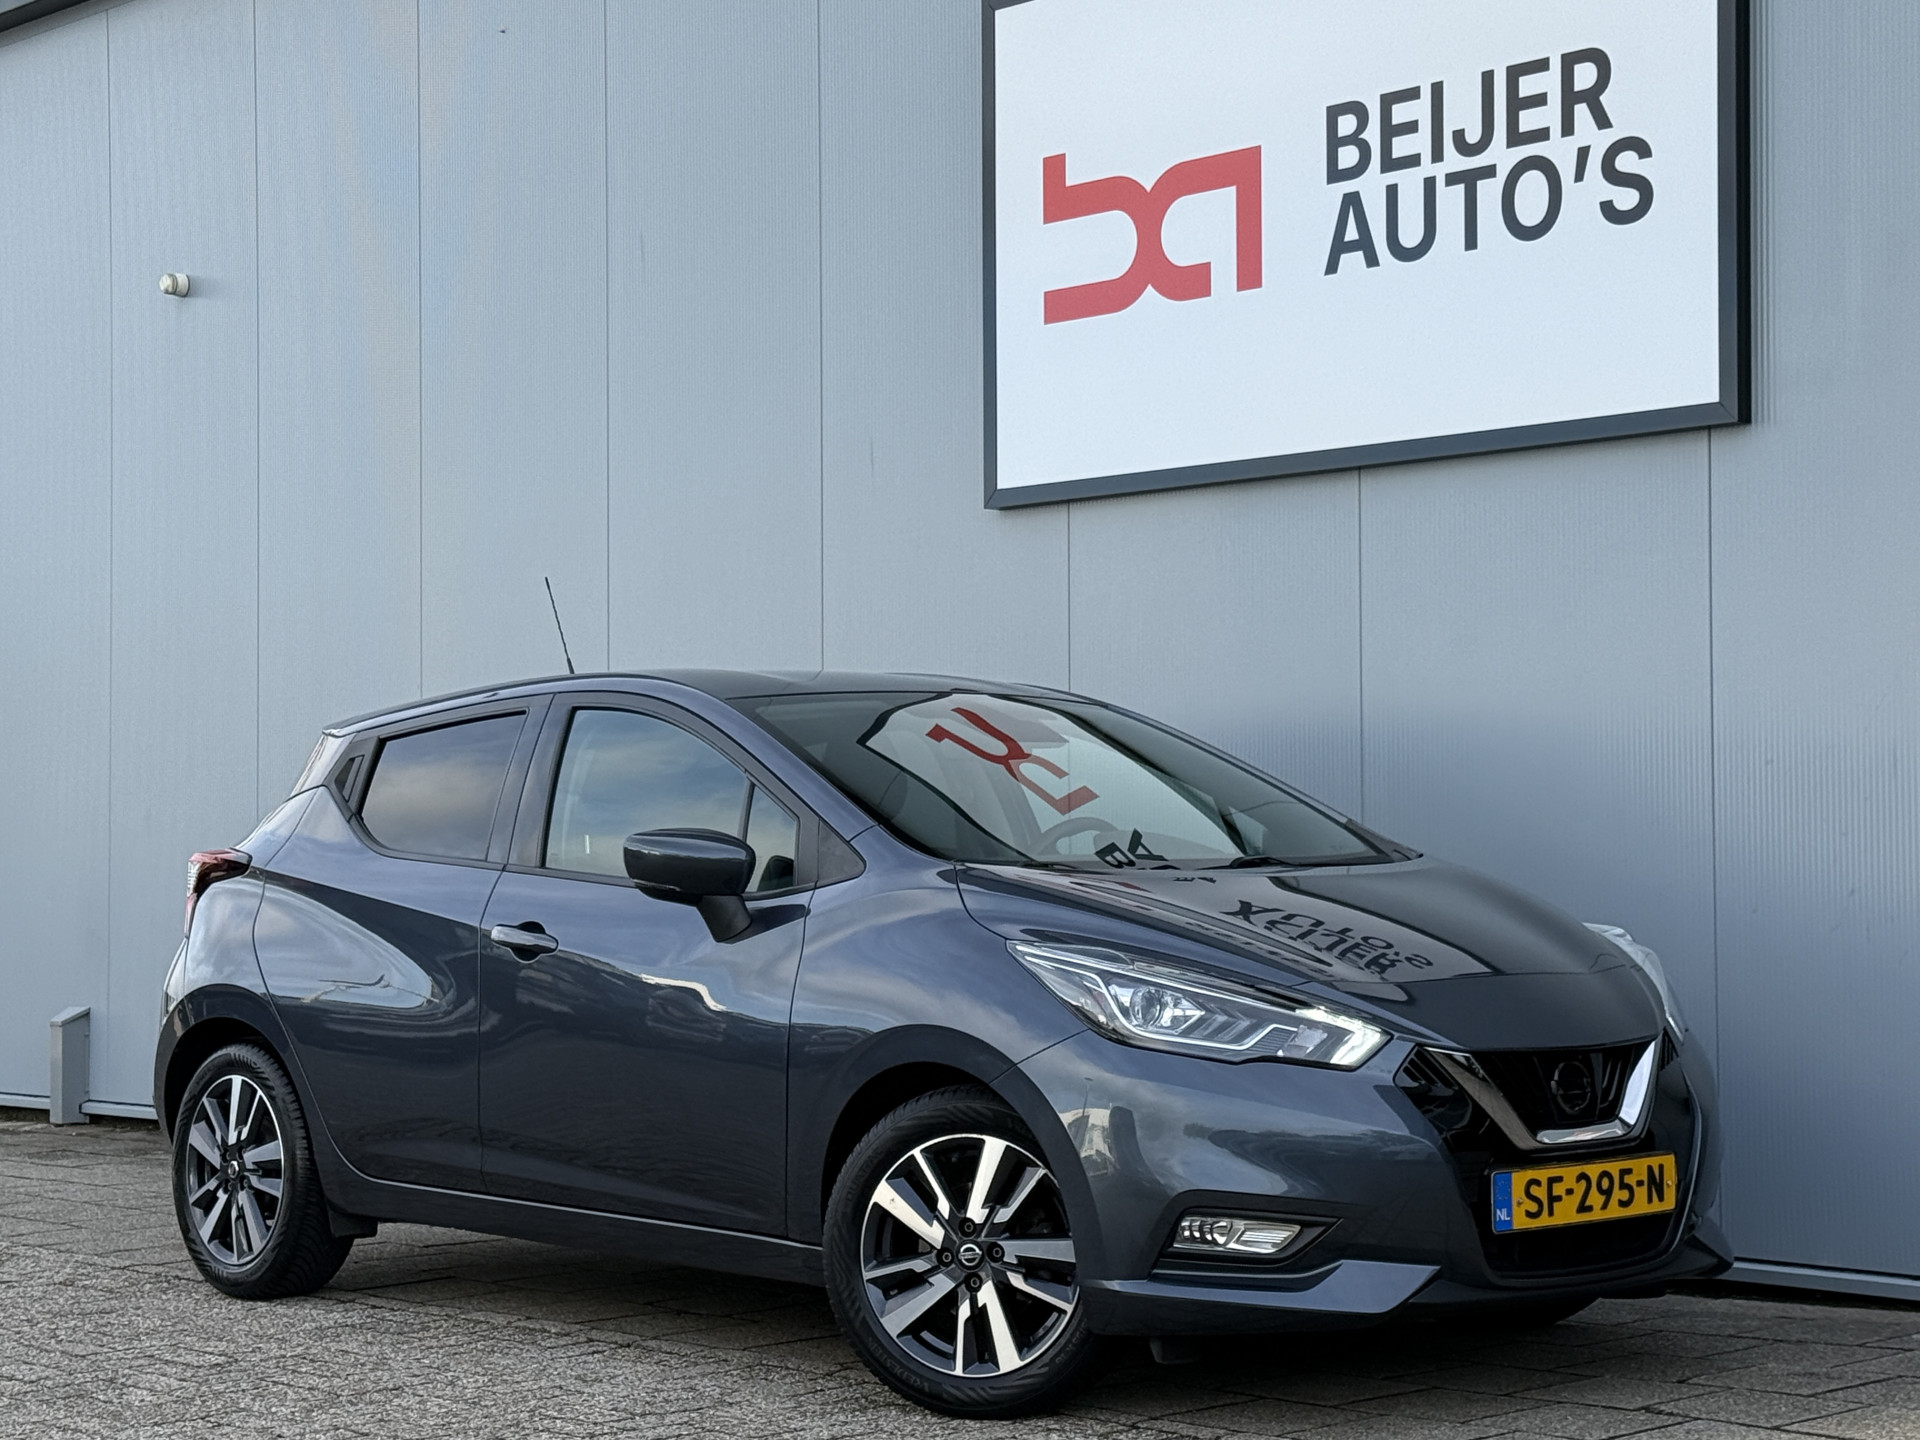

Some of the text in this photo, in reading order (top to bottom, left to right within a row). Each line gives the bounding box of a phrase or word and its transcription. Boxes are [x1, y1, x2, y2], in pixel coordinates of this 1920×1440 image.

[1325, 47, 1613, 185] BEIJER
[1324, 136, 1654, 276] AUTO'S
[1496, 1208, 1511, 1221] NL
[1524, 1163, 1665, 1219] SF-295-N
